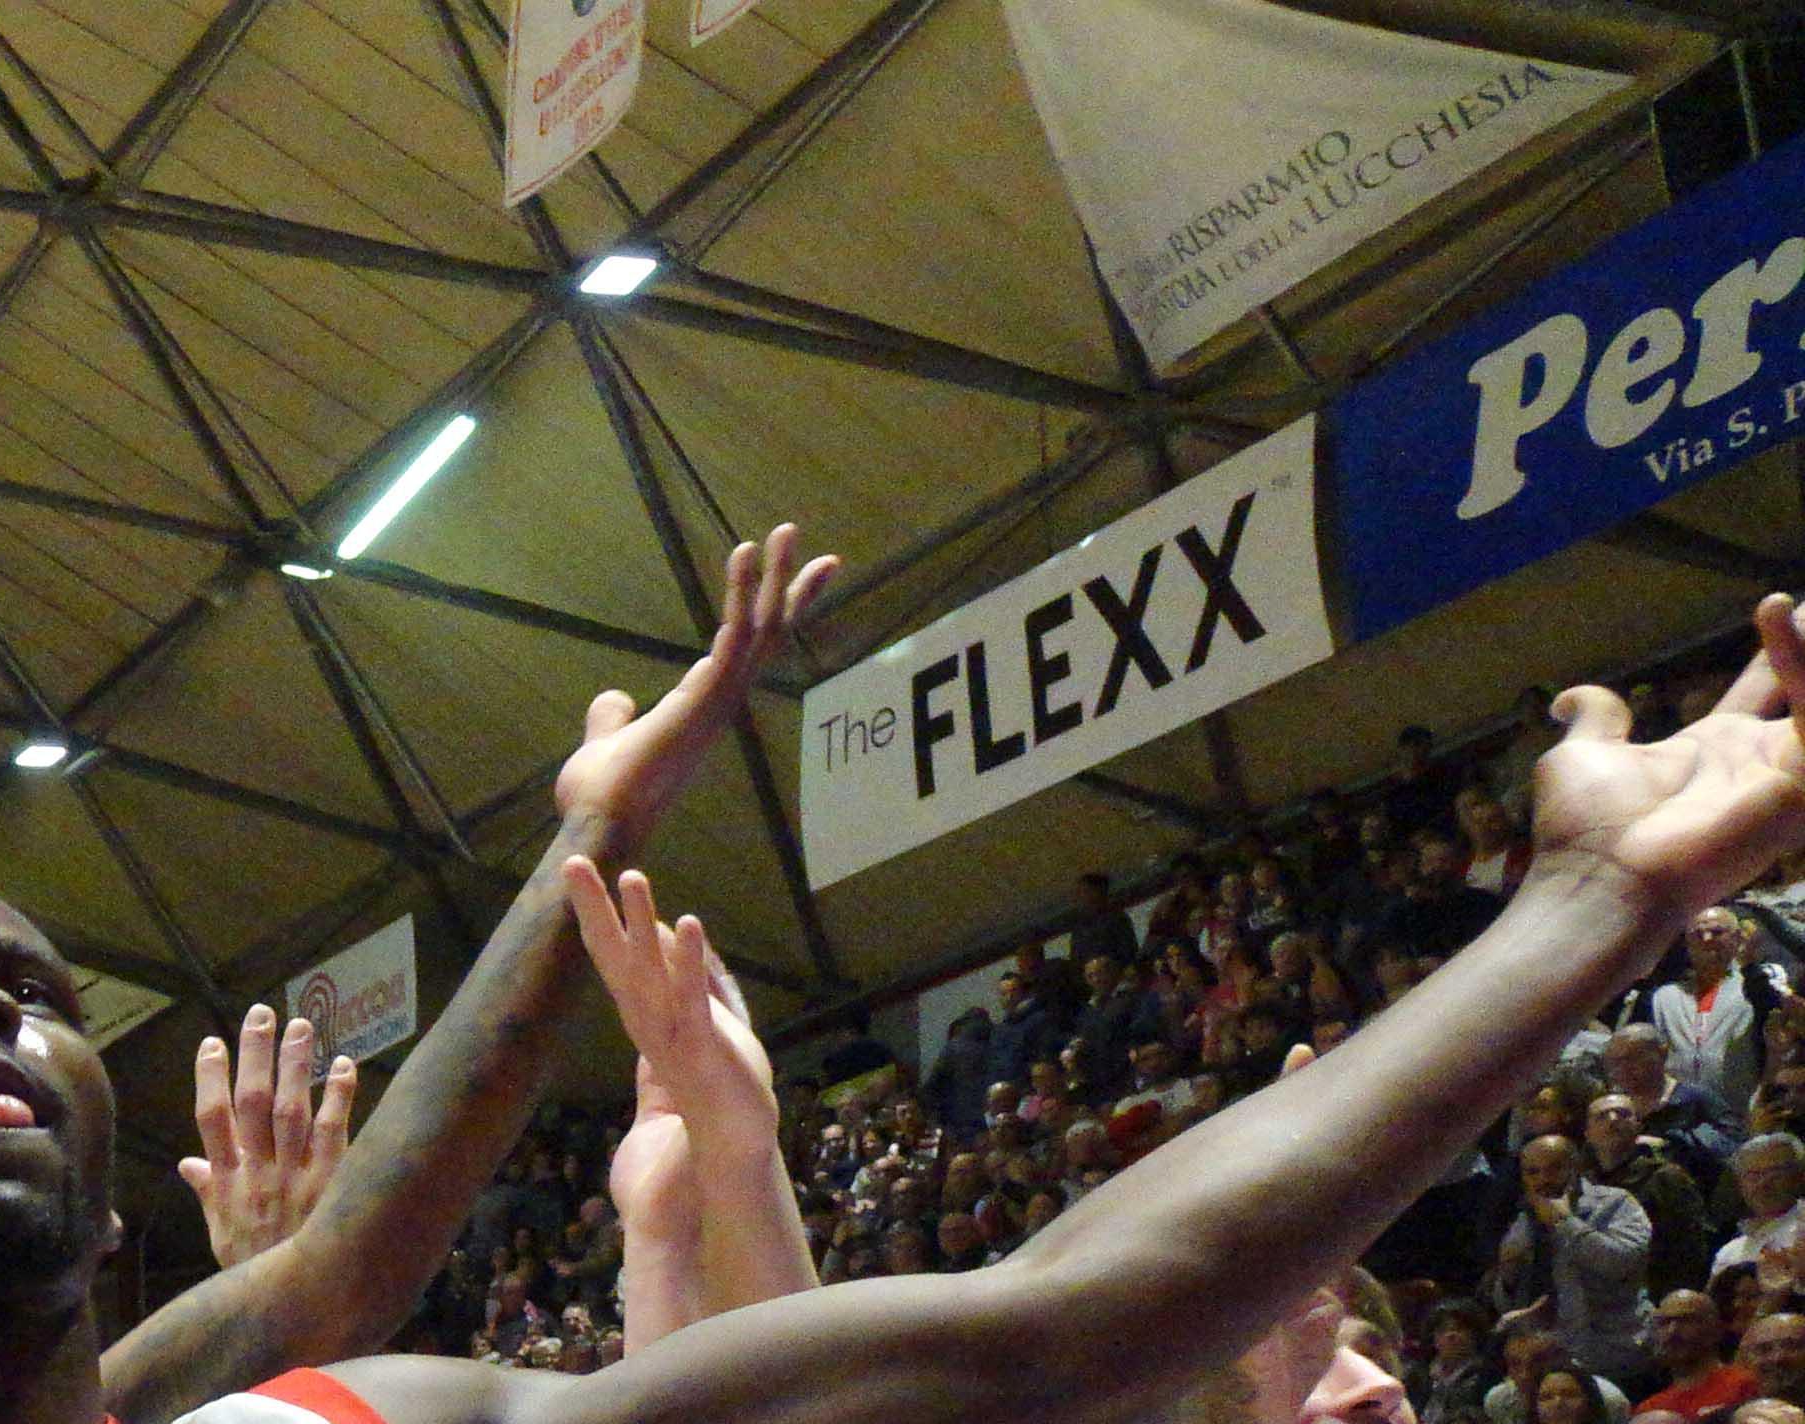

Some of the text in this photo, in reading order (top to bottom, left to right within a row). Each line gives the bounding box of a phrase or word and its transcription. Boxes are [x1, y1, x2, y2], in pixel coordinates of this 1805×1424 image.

[1167, 130, 1352, 265] RISPARMIO
[1303, 62, 1557, 226] LUCCHESIA
[1456, 236, 1805, 520] Per
[1645, 437, 1717, 483] Via
[819, 706, 897, 773] The
[910, 489, 1268, 800] FLEXX
